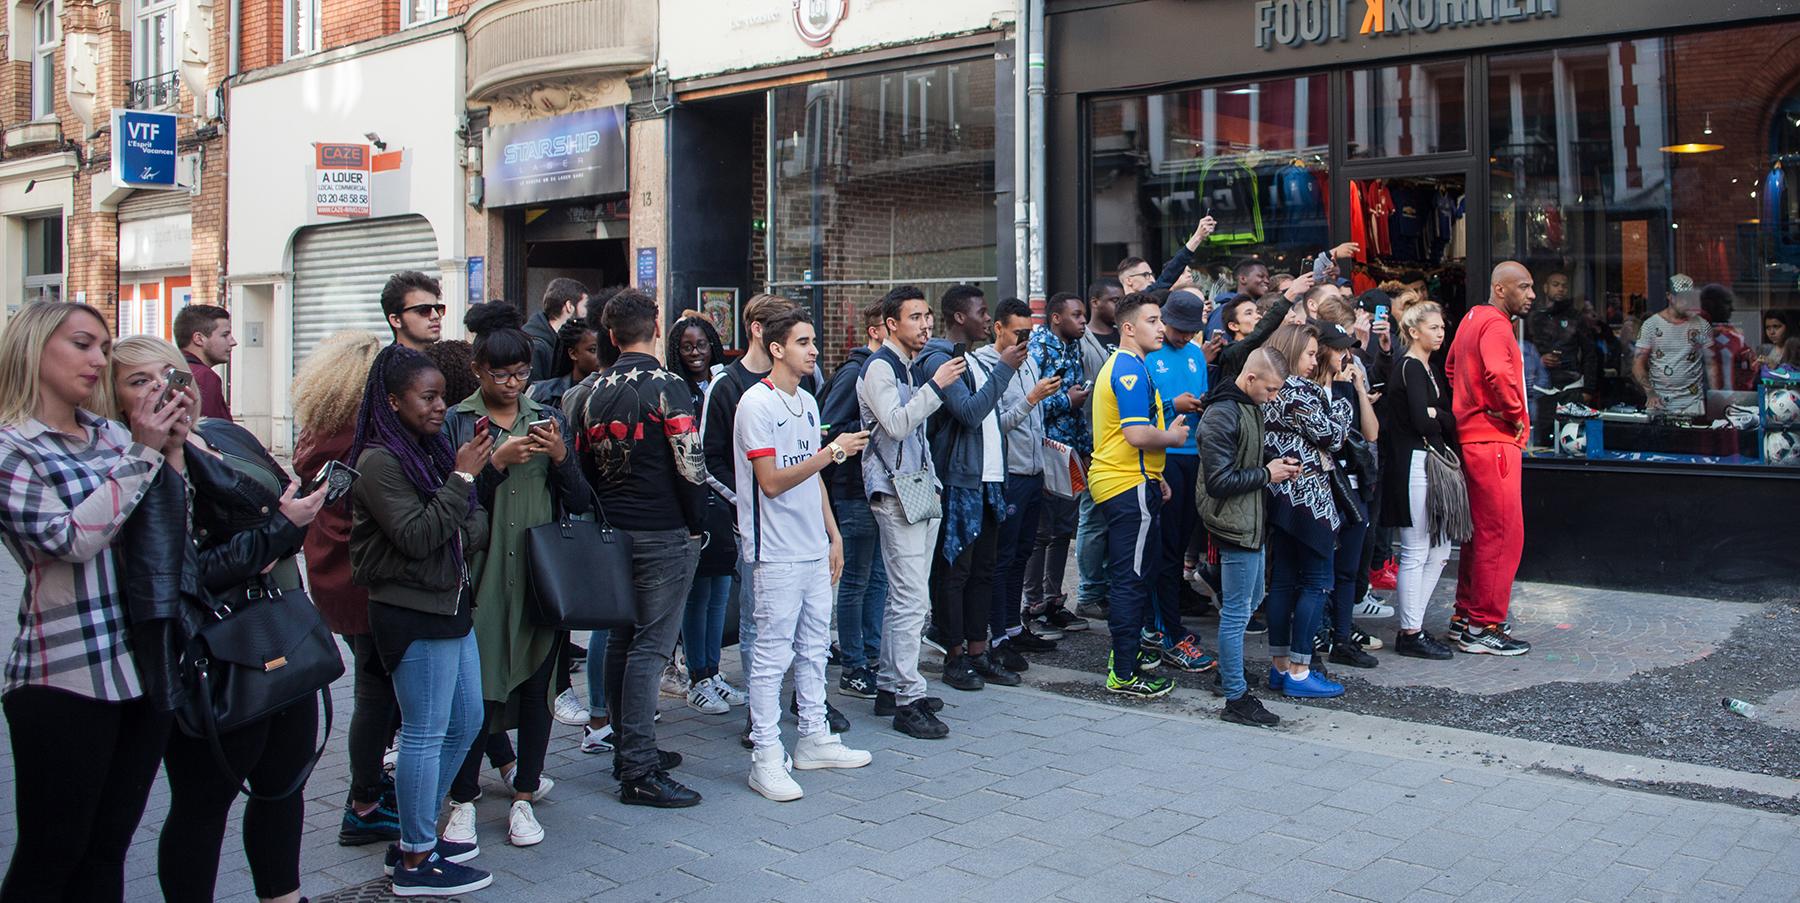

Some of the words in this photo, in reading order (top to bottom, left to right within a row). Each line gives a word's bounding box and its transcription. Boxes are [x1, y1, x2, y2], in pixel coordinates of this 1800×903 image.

[1254, 0, 1339, 48] FOOT
[127, 121, 160, 141] VTF
[127, 140, 152, 149] L'Esprit
[504, 130, 600, 165] STARSHIP
[142, 147, 174, 156] Vacances
[323, 146, 361, 160] CAZE
[322, 172, 330, 183] A
[332, 172, 364, 184] LOUER
[335, 185, 368, 193] COMMERCIAL
[317, 194, 327, 203] 03
[328, 194, 338, 203] 20
[339, 194, 348, 204] 48
[349, 194, 358, 204] 58
[359, 194, 368, 205] 58
[641, 191, 652, 207] 13
